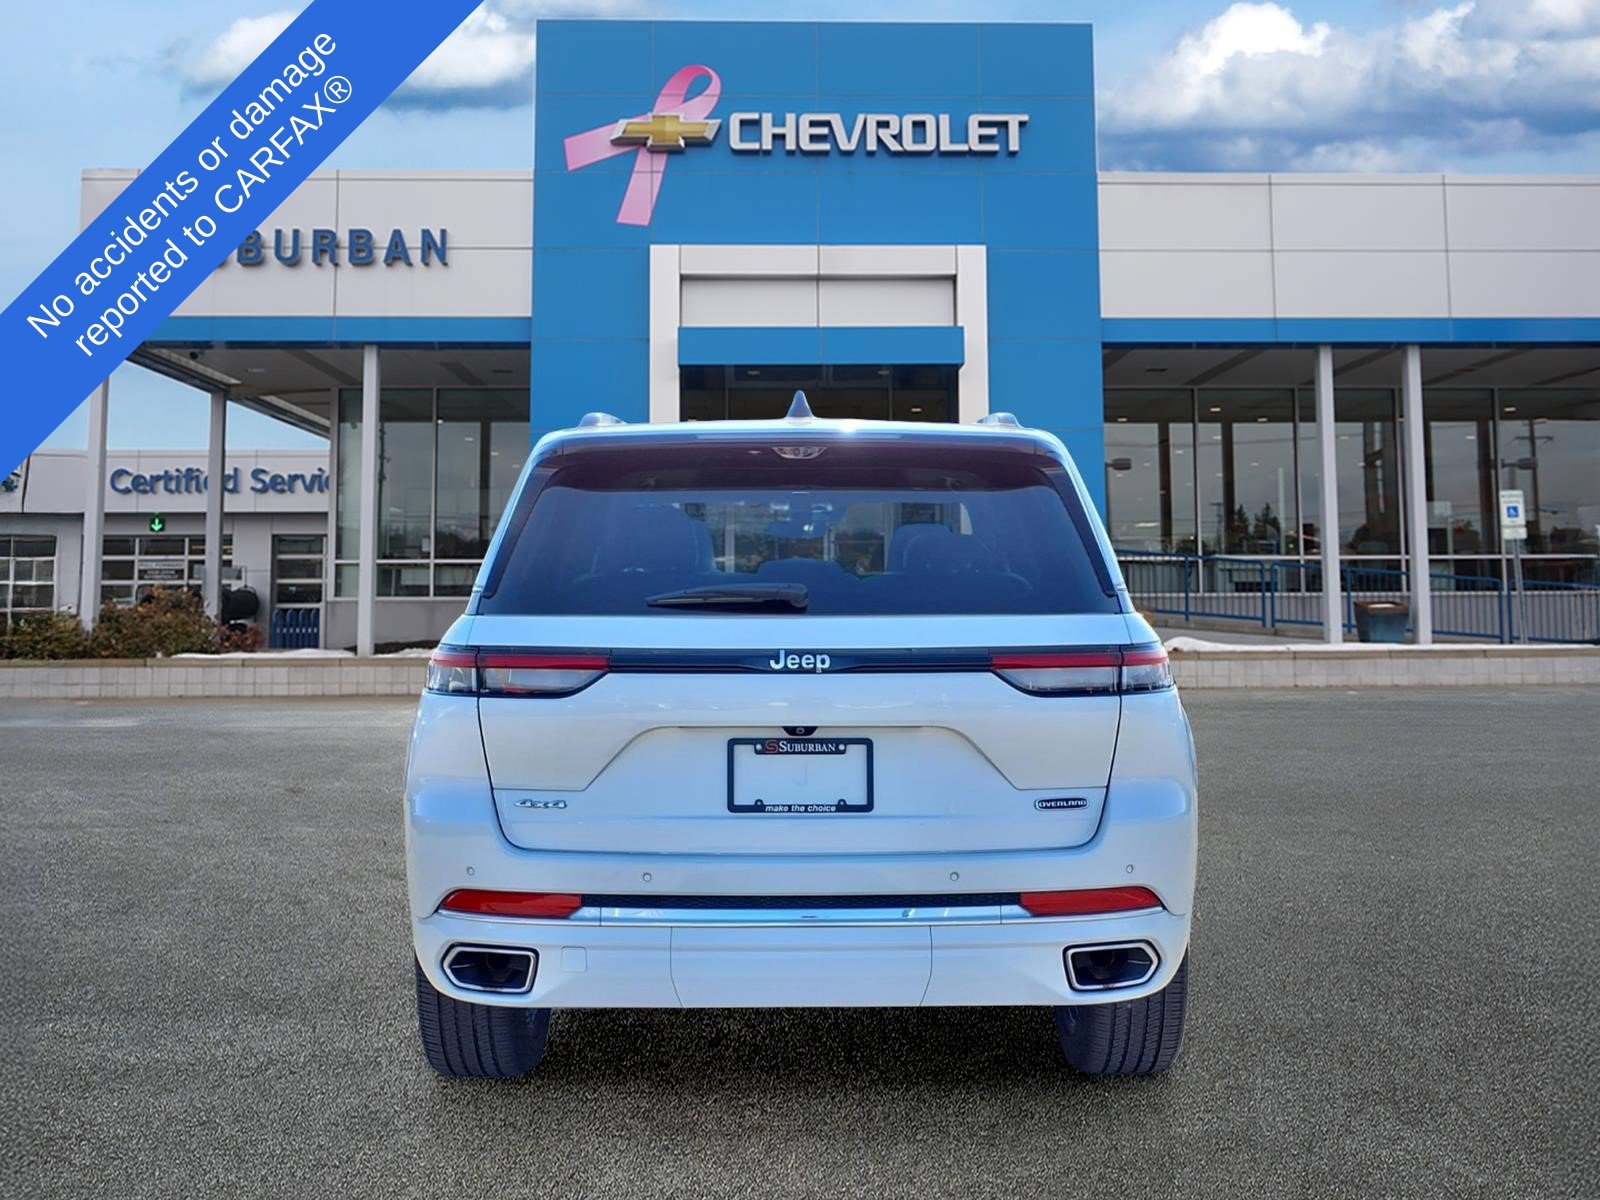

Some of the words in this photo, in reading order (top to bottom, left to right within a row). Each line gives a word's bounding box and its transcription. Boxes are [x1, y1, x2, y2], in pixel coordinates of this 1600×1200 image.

[729, 112, 1029, 152] CHEVROLET
[220, 229, 449, 267] BURBAN
[250, 467, 330, 494] Servi
[770, 649, 830, 673] Jeep
[765, 804, 789, 812] make
[791, 804, 805, 812] the
[807, 804, 836, 812] choice
[1039, 799, 1087, 808] OVERLAND
